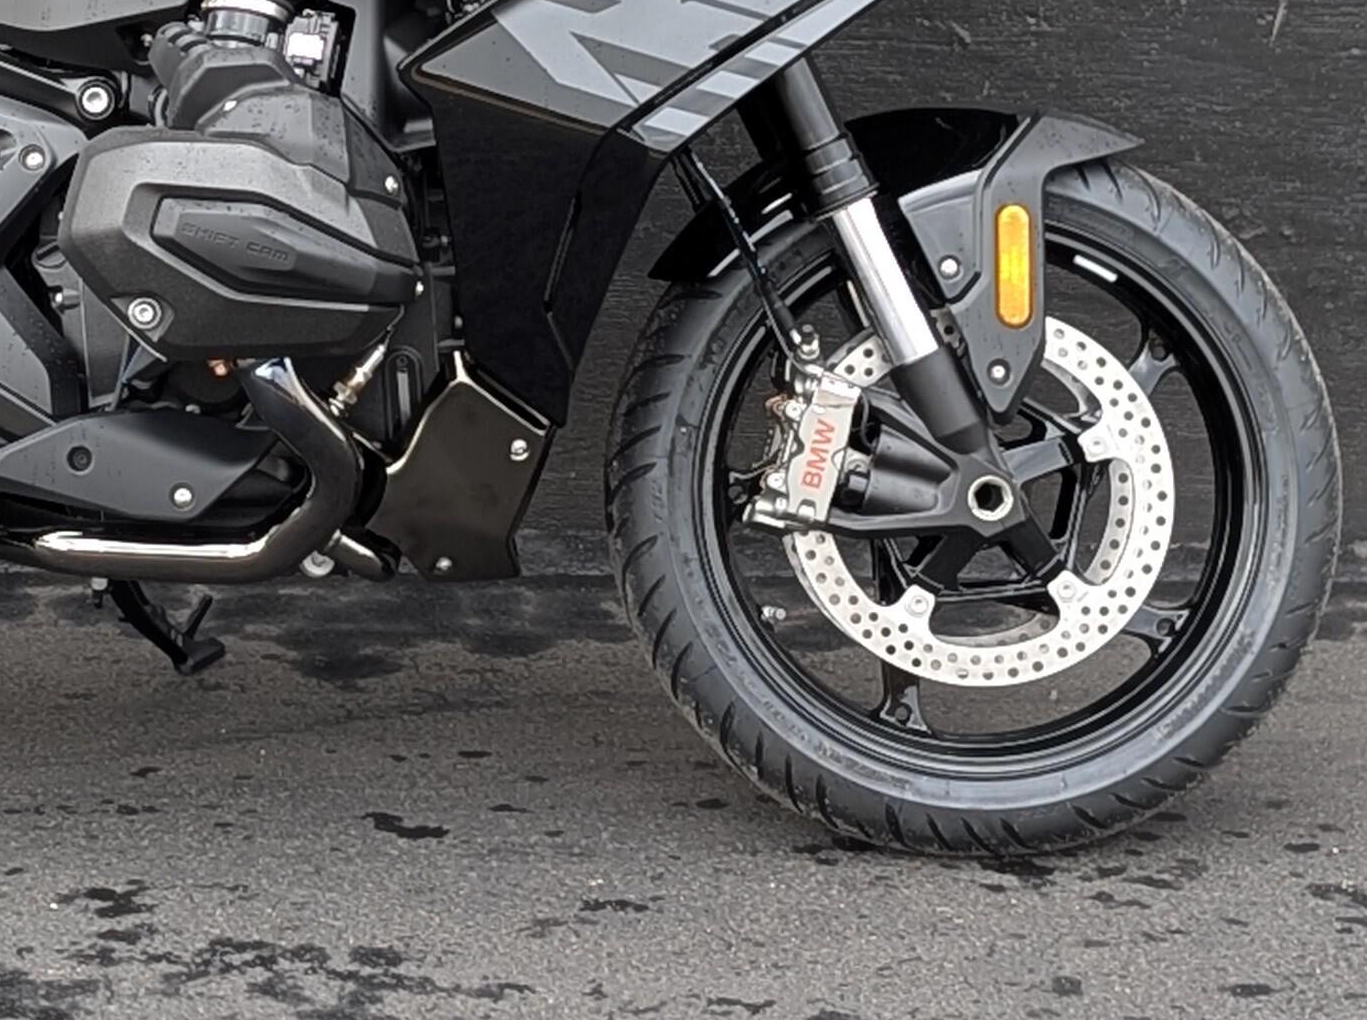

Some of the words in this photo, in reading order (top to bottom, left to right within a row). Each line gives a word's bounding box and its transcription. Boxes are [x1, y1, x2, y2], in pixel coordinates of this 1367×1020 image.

[181, 221, 241, 249] SHIFT
[245, 241, 290, 262] CAM
[801, 418, 836, 490] BMW
